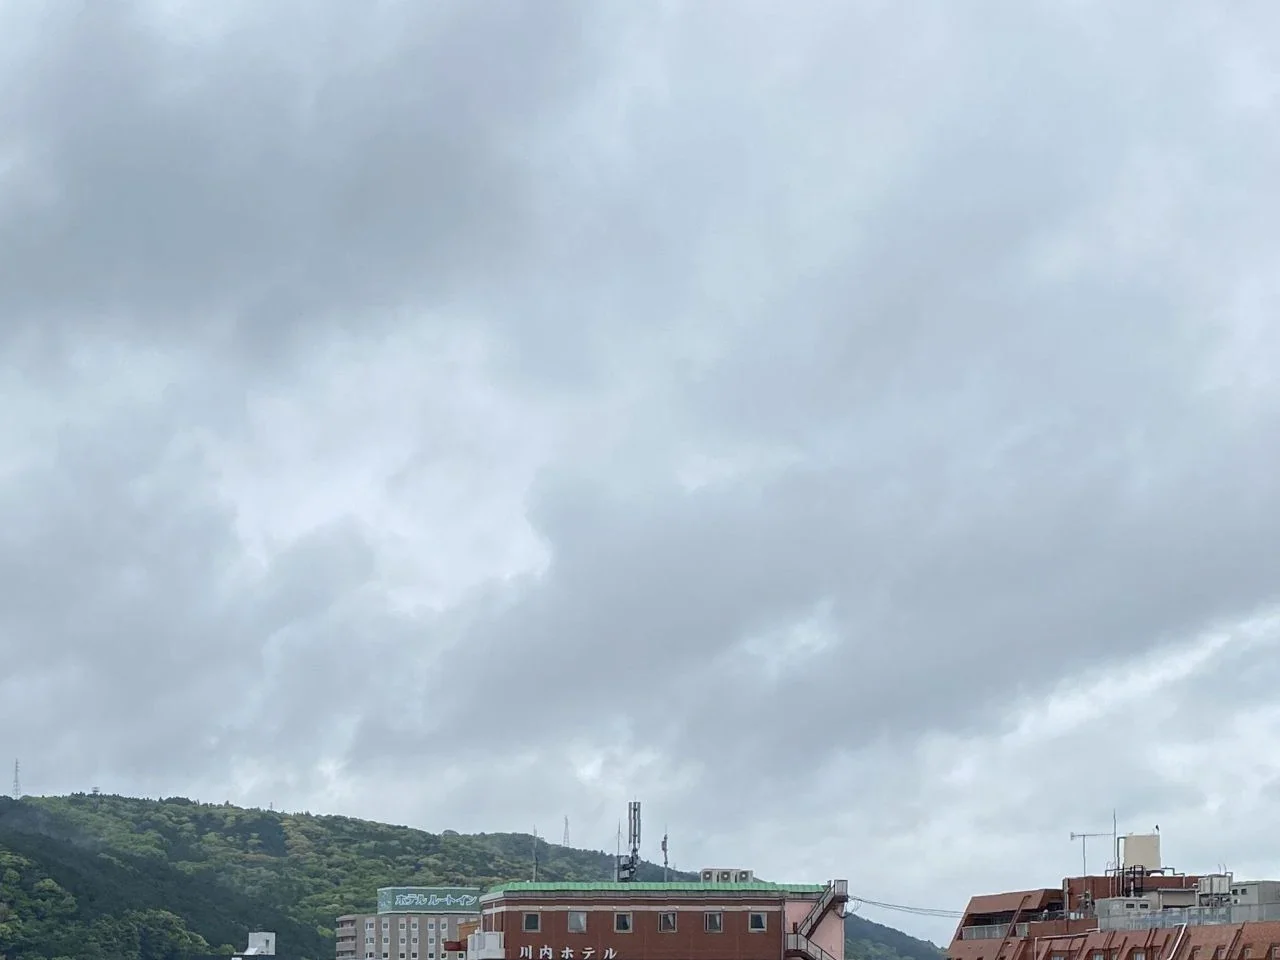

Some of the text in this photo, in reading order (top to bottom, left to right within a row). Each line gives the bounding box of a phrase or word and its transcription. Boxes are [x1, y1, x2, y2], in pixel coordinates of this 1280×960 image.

[520, 945, 617, 960] 川内ホテル
